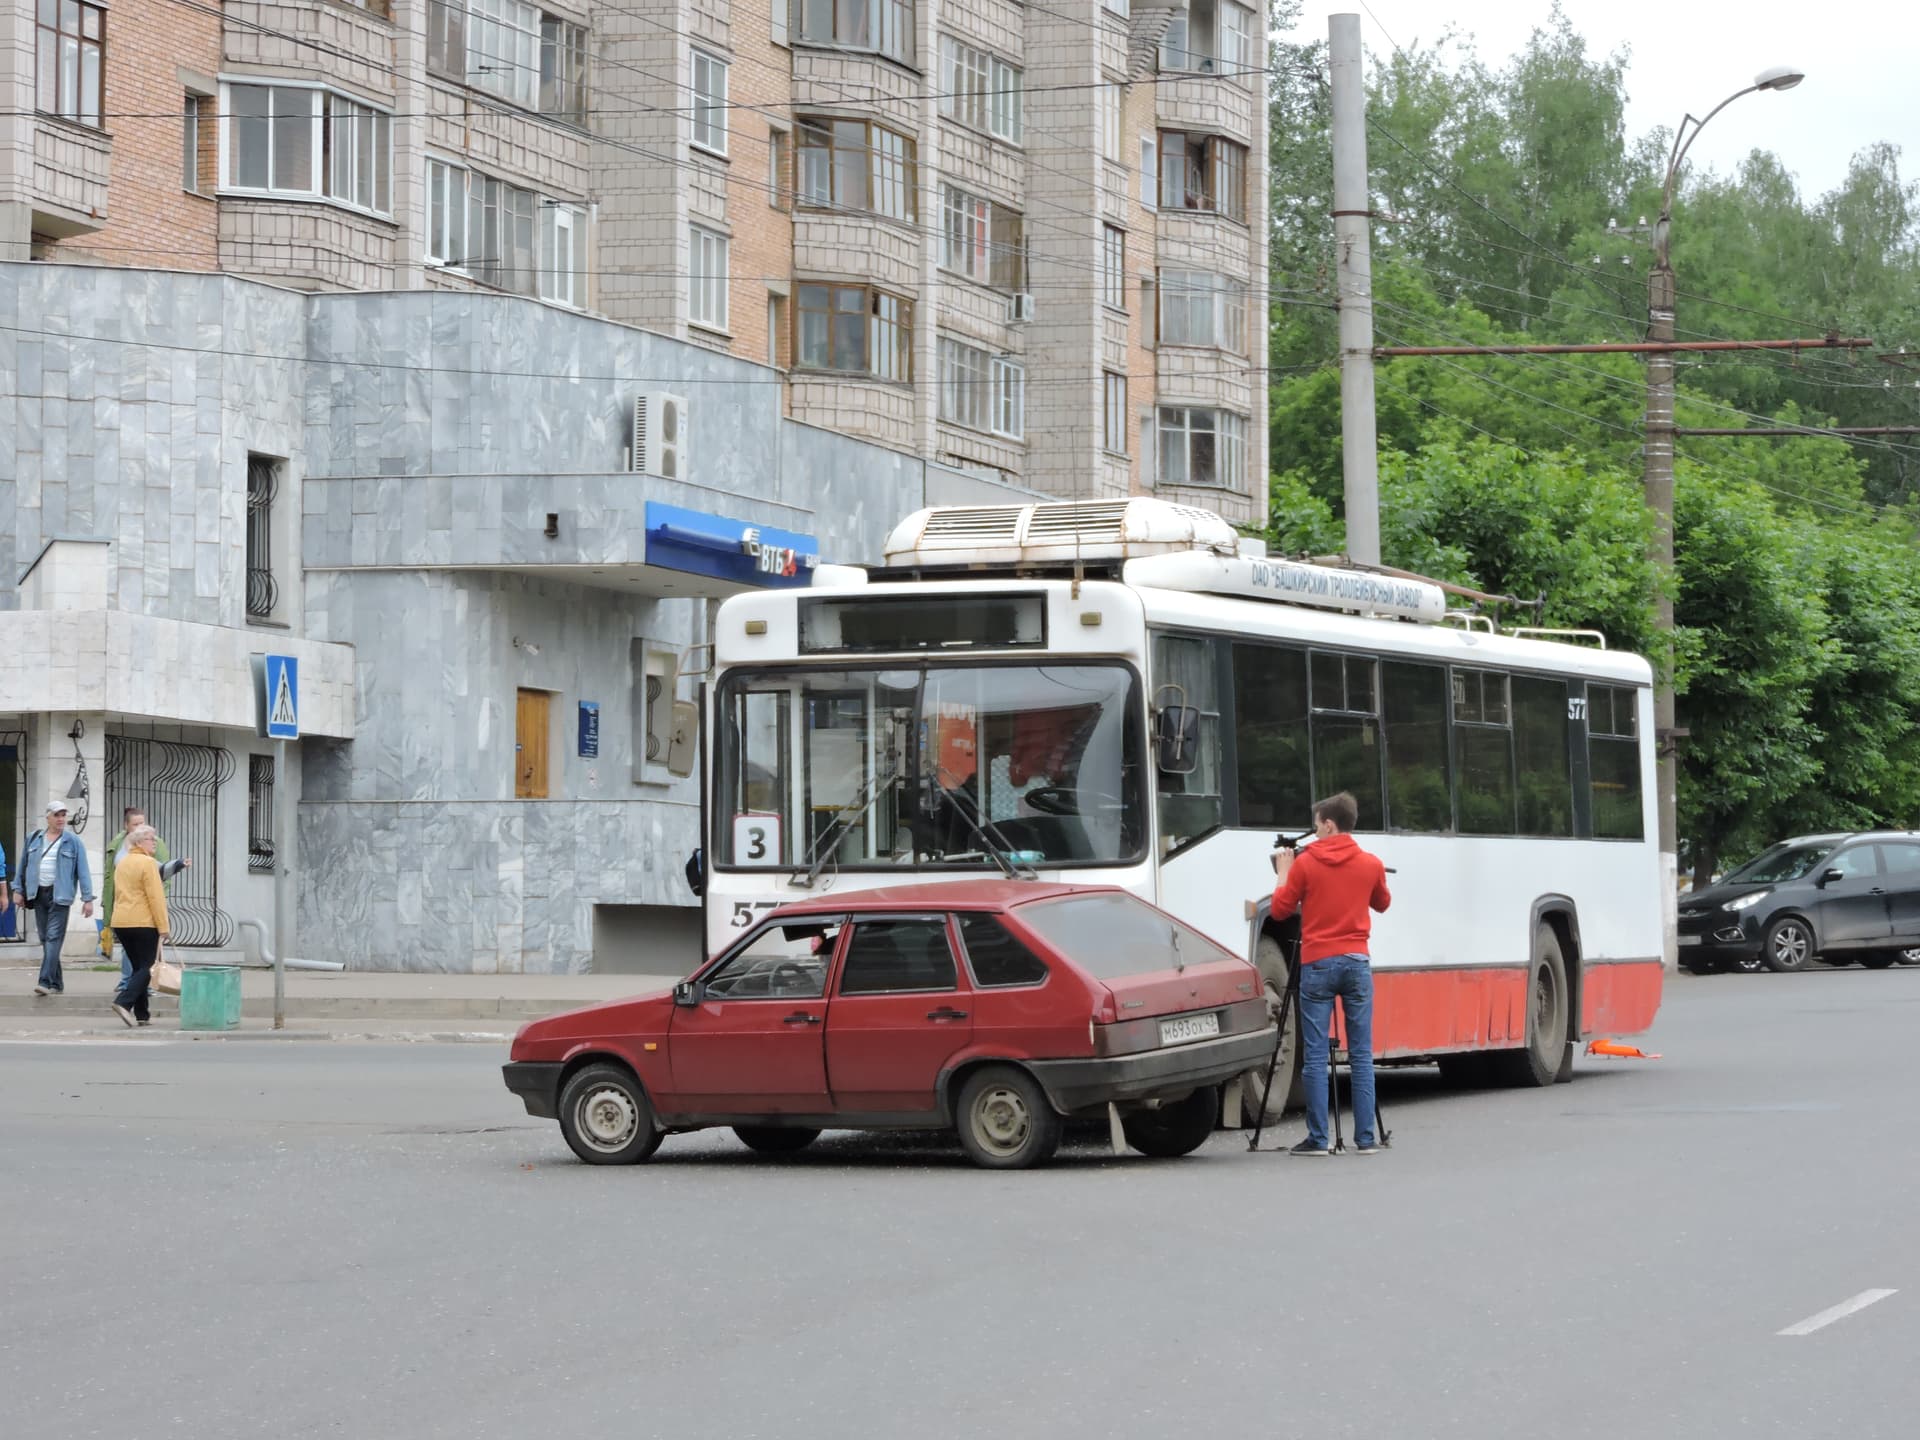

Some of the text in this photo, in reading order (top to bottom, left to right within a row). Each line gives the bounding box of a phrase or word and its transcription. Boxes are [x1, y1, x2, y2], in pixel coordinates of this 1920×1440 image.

[1252, 563, 1269, 587] ОАО
[1568, 698, 1586, 720] 577
[747, 826, 766, 860] 3
